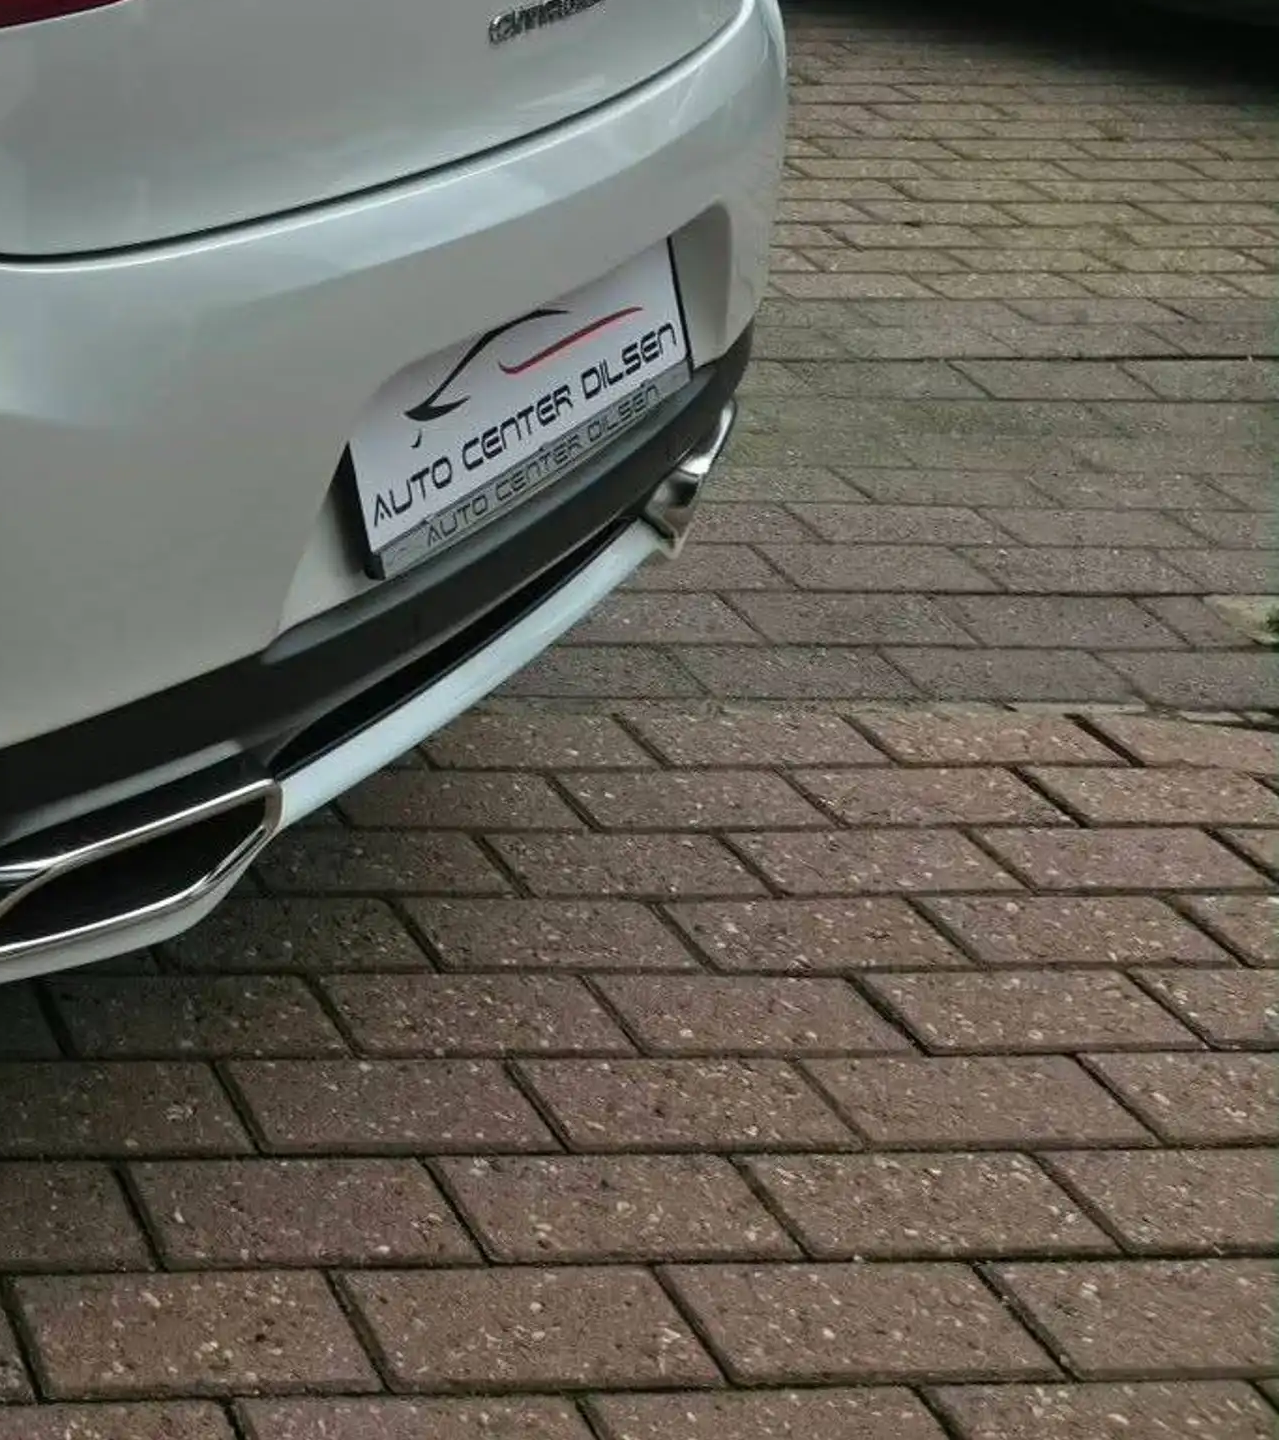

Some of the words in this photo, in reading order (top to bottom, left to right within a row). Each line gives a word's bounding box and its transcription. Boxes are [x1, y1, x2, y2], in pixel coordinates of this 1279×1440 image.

[373, 456, 454, 528] AUTO
[461, 384, 575, 471] CENTER
[580, 322, 678, 401] DILSEN
[426, 494, 489, 547] AUTO
[494, 436, 583, 502] CENTER
[585, 383, 663, 445] DILSEN
